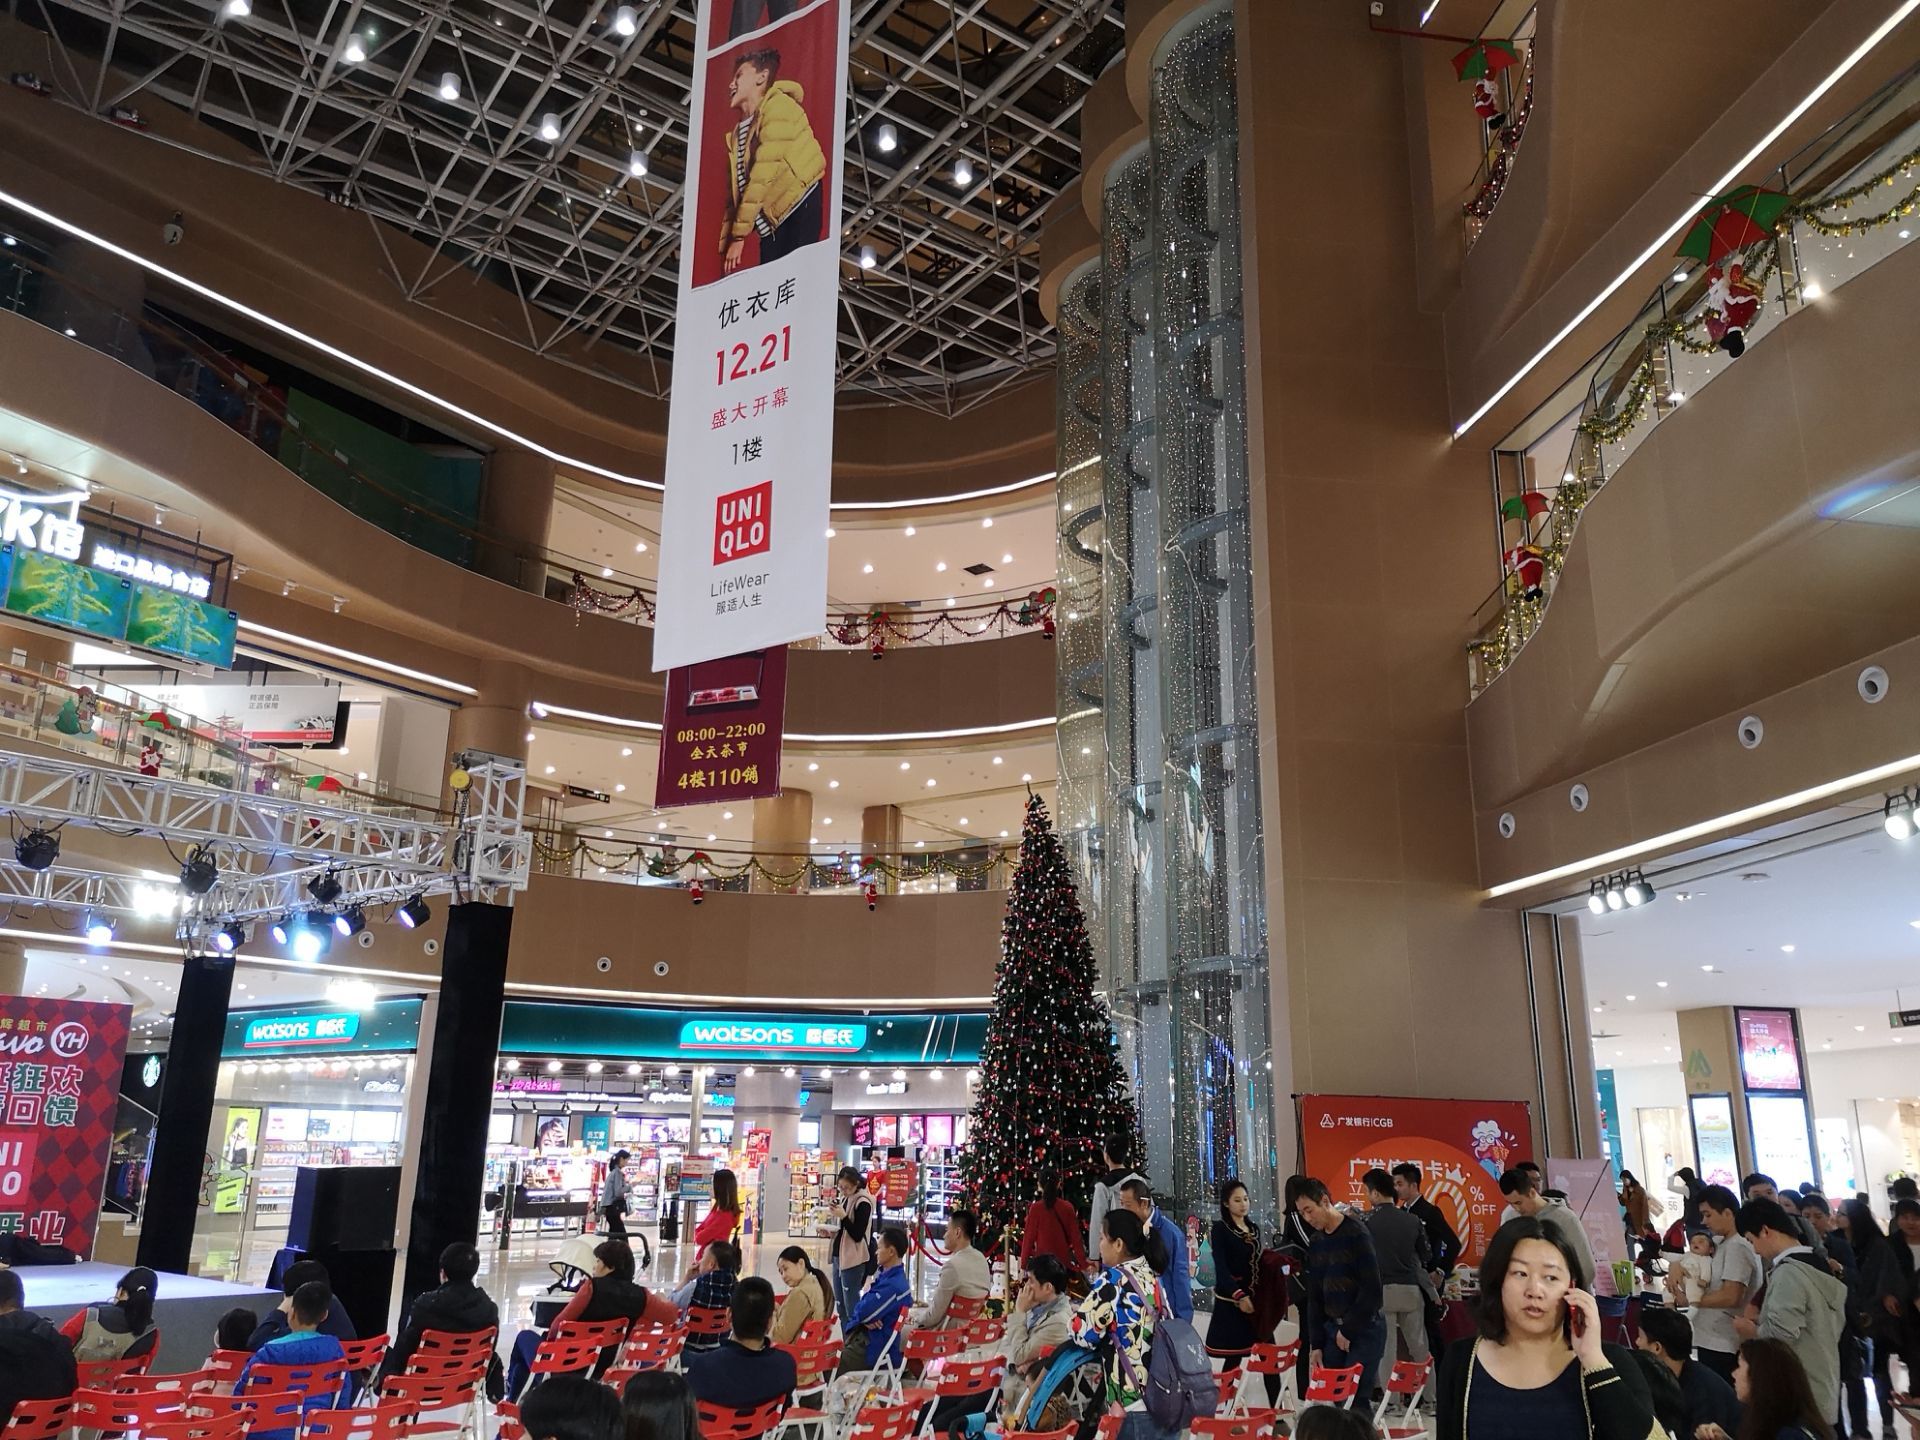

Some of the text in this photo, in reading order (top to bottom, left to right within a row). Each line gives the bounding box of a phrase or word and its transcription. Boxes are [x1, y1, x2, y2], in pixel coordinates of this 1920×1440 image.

[718, 277, 797, 330] 优衣库
[716, 325, 791, 386] 12.21
[711, 387, 789, 430] 盛大开幕
[732, 436, 763, 466] 1楼
[721, 492, 762, 526] UNI
[719, 521, 765, 558] QLO
[711, 572, 770, 598] LifeWear
[715, 592, 763, 616] 服适人生
[677, 722, 766, 743] 08:00-22:00
[690, 741, 749, 761] 全天茶市
[59, 1031, 86, 1049] YH
[253, 1022, 309, 1041] watsons
[694, 1025, 795, 1044] watsons
[0, 1094, 78, 1127] 回馈
[1373, 1117, 1394, 1128] CGB
[1469, 1185, 1485, 1201] %
[1472, 1203, 1497, 1216] OFF
